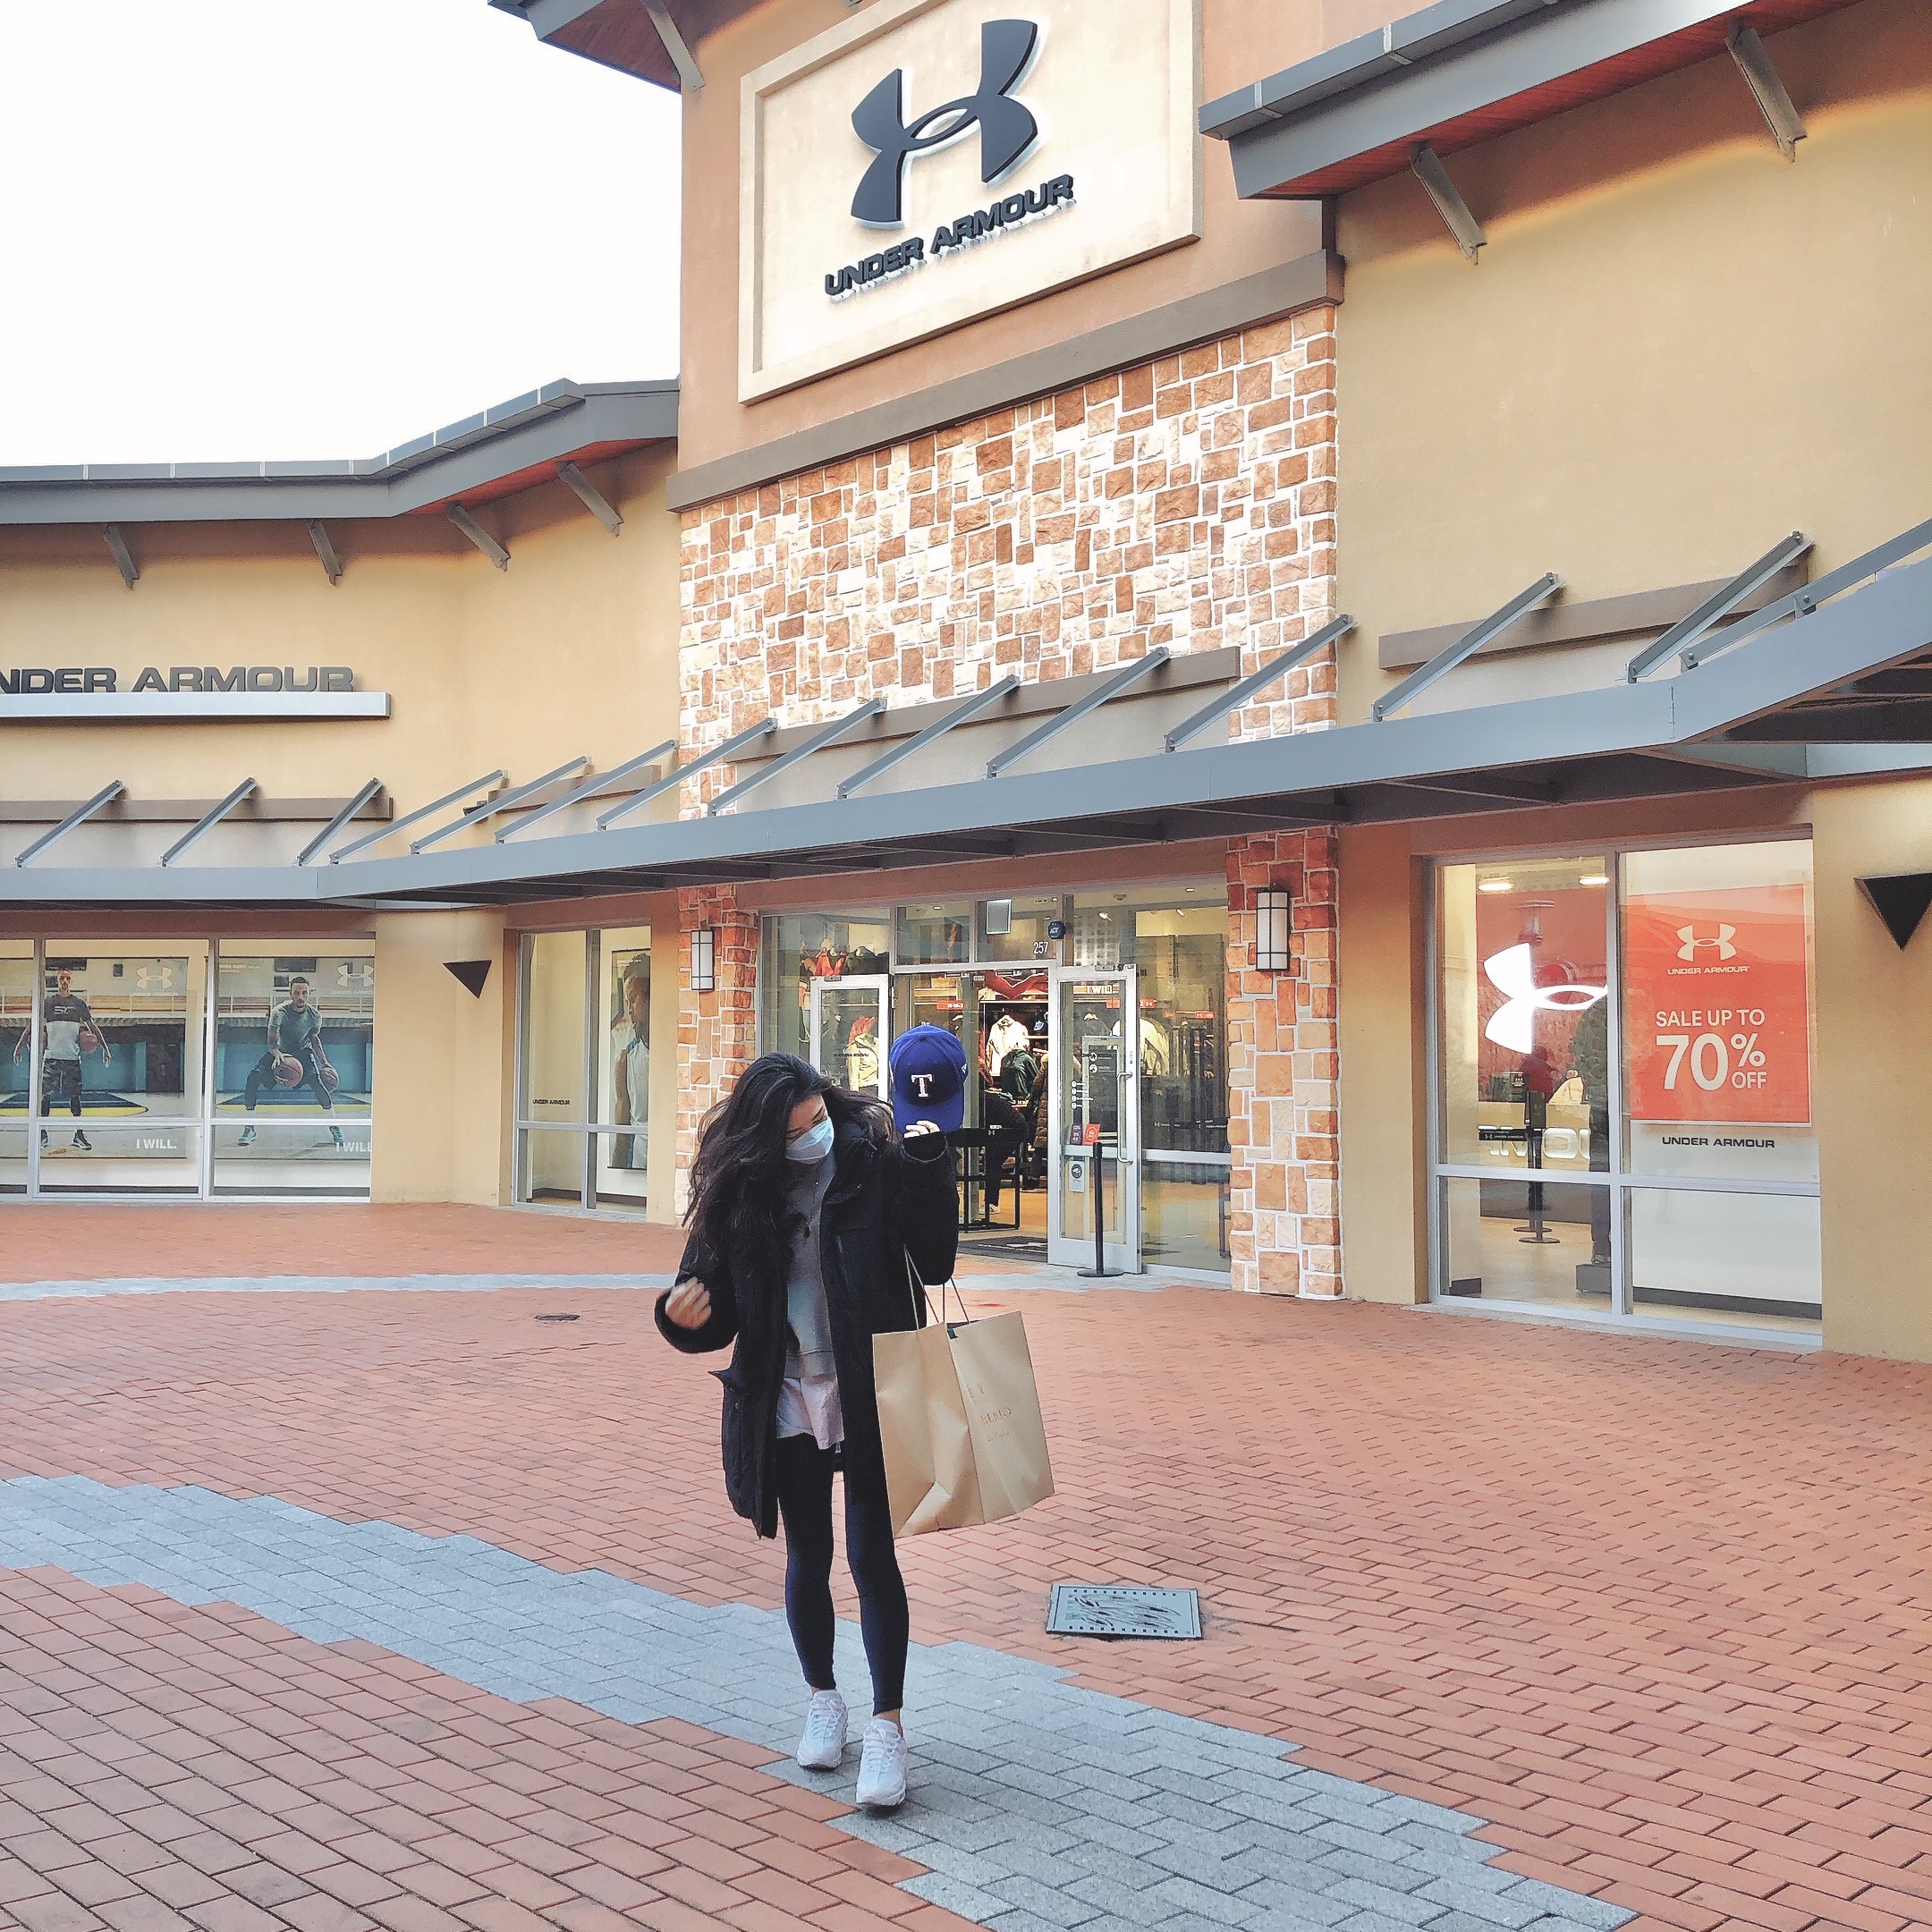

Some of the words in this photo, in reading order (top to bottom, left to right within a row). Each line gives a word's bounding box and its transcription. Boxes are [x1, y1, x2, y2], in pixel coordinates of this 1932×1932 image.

[825, 237, 925, 296] UNDER
[929, 174, 1074, 255] ARMOUR
[131, 665, 354, 692] ARMOUR
[1033, 941, 1049, 954] 257
[1667, 967, 1701, 975] UNDER
[1703, 965, 1750, 974] ARMOUR
[1656, 1010, 1703, 1027] SALE
[1707, 1009, 1733, 1026] UP
[1736, 1008, 1766, 1026] TO
[1656, 1032, 1767, 1091] 70%
[1731, 1071, 1767, 1089] OFF
[911, 1073, 933, 1097] T
[136, 1139, 140, 1148] I
[335, 1141, 340, 1152] I
[1662, 1136, 1708, 1146] UNDER
[1713, 1138, 1775, 1148] ARMOUR
